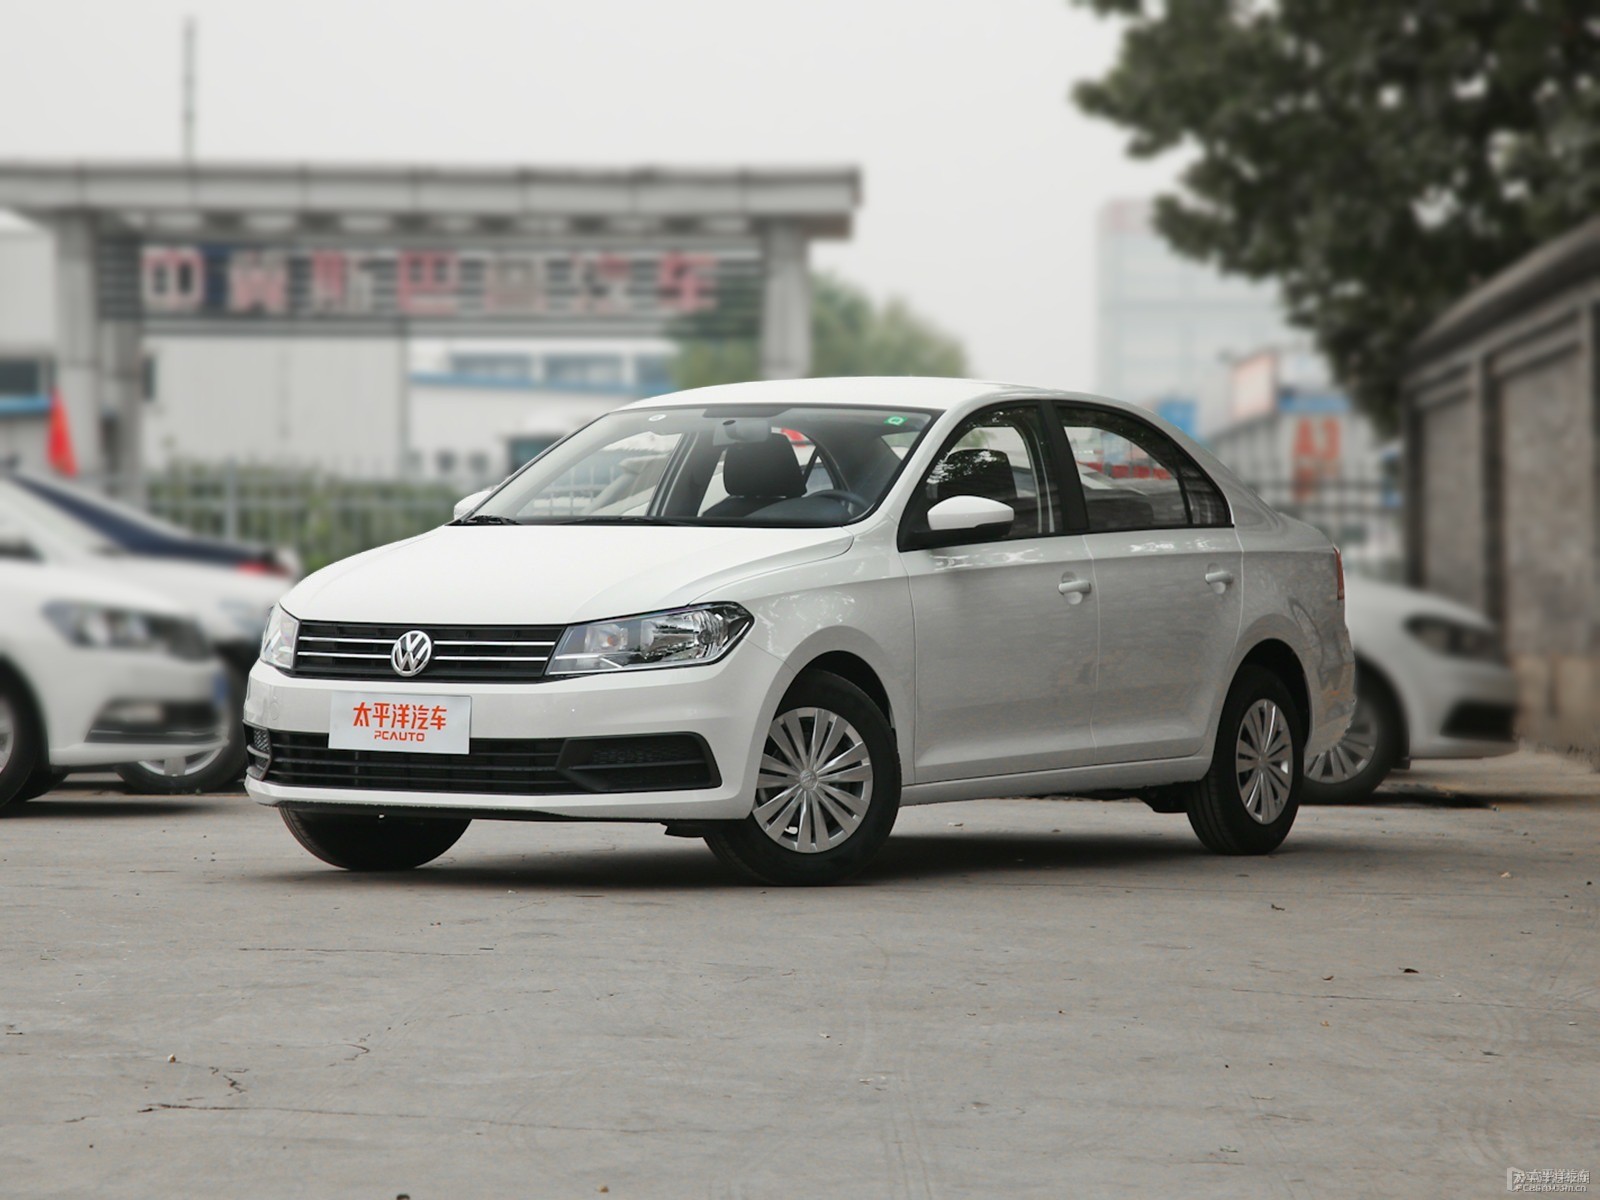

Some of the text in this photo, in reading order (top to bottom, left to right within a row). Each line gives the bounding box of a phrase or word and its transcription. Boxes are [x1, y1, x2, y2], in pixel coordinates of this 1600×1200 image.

[353, 702, 447, 730] 太平洋汽车
[374, 730, 425, 742] PCAUTO
